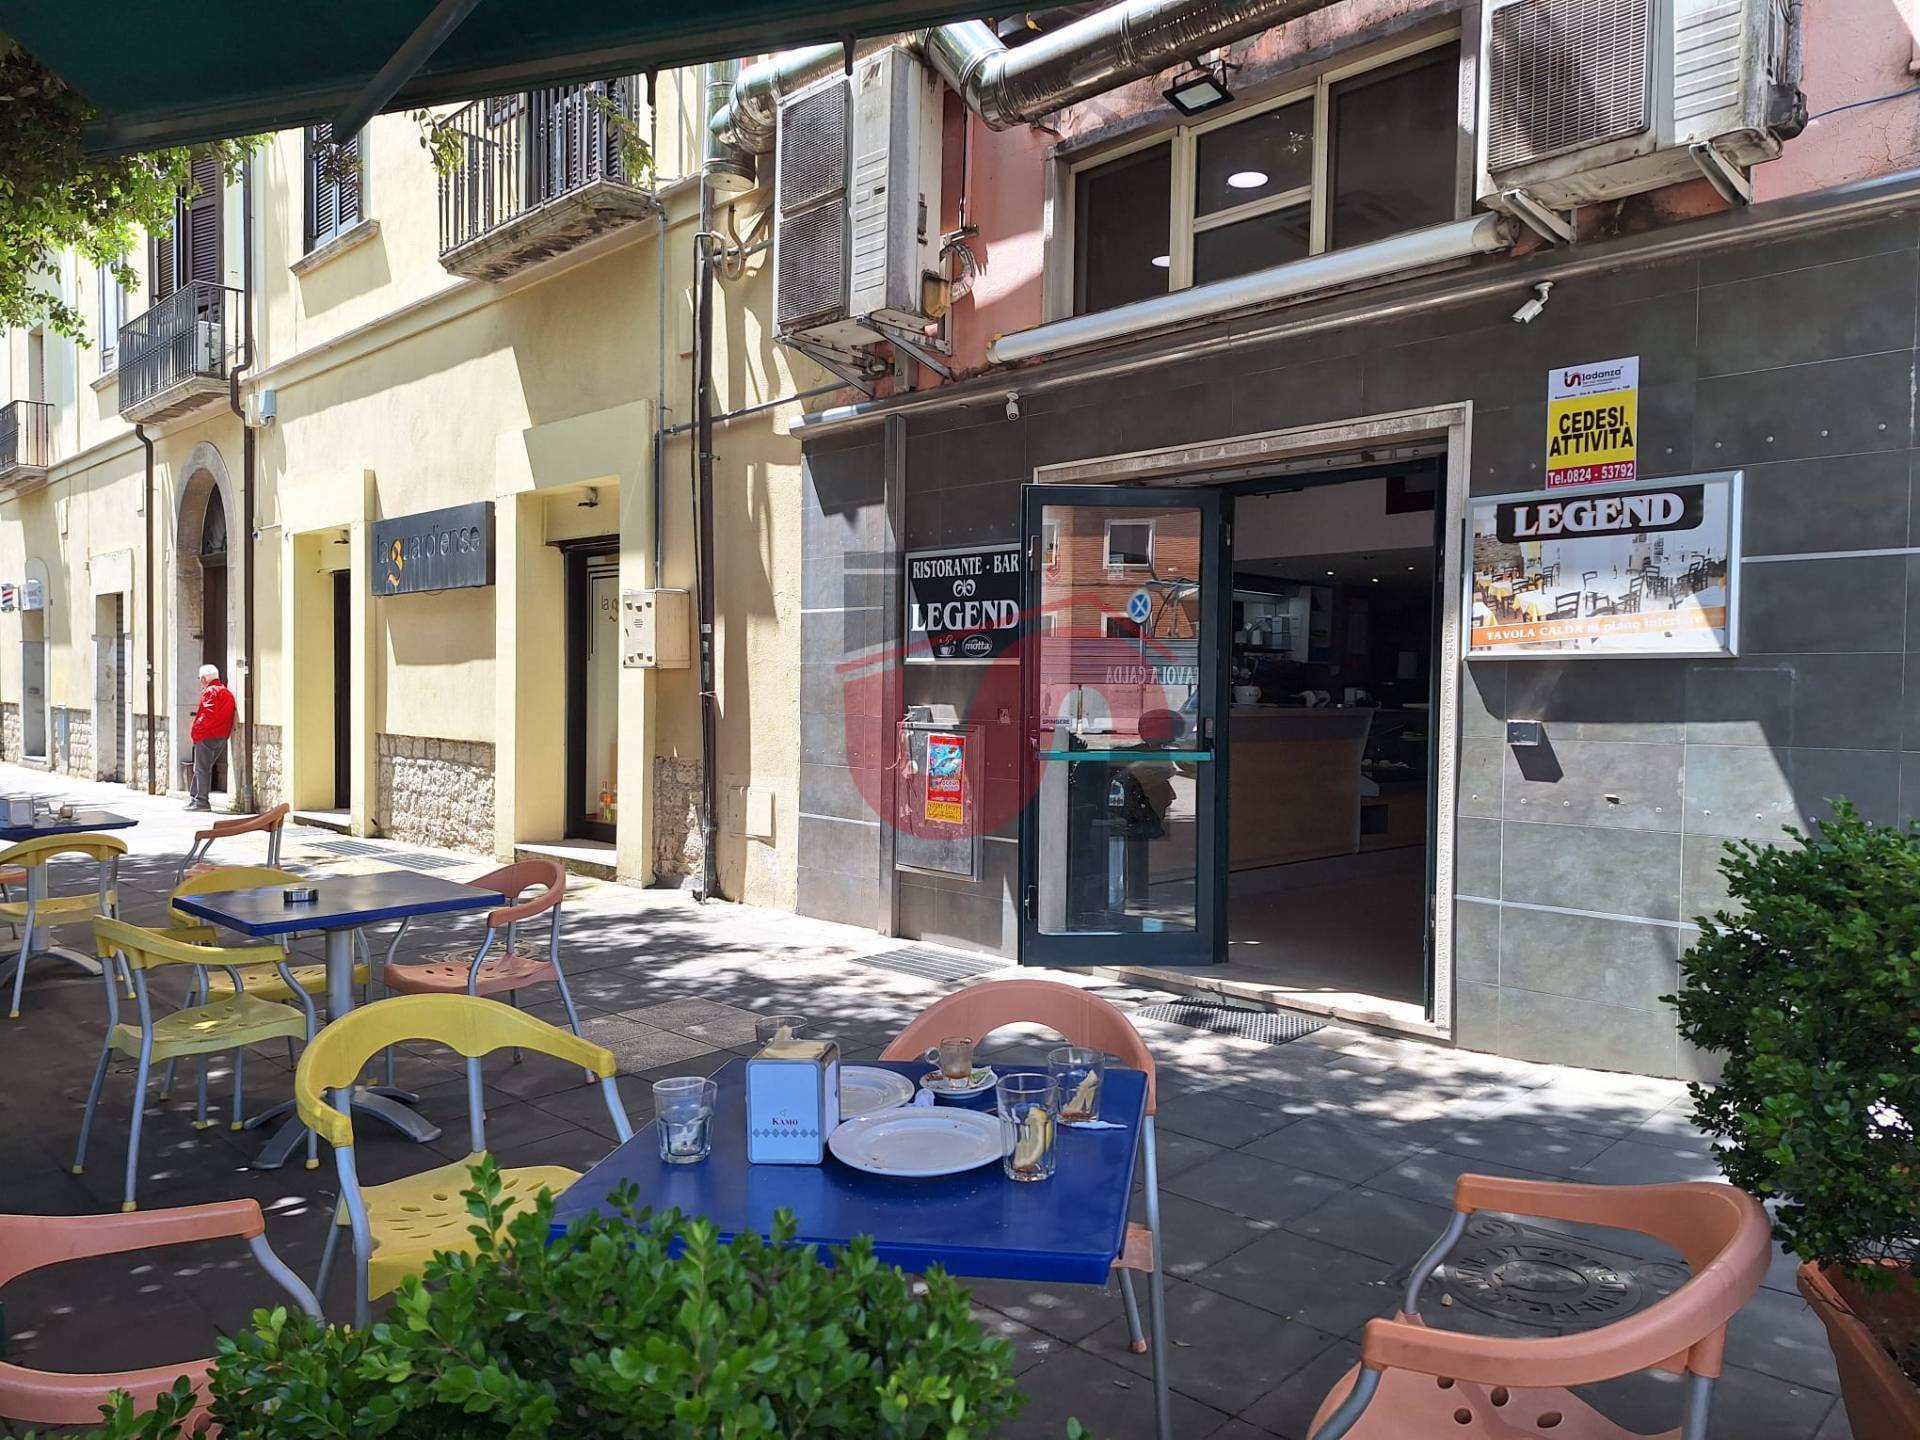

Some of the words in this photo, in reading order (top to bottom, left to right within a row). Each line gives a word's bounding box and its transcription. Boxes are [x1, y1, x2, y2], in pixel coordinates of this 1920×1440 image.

[1559, 405, 1625, 434] CEDESI
[1549, 422, 1634, 457] ATTIVITÀ
[1549, 466, 1592, 485] Tel.0824
[1601, 463, 1633, 480] 53792
[1513, 493, 1685, 537] LEGEND
[912, 557, 983, 579] RISTORANTE
[993, 554, 1020, 574] BAR
[911, 600, 1020, 631] LEGEND
[964, 641, 990, 650] motta
[1487, 628, 1535, 641] TAVOLA
[1539, 625, 1583, 637] CALDA
[772, 1117, 798, 1126] KAMO
